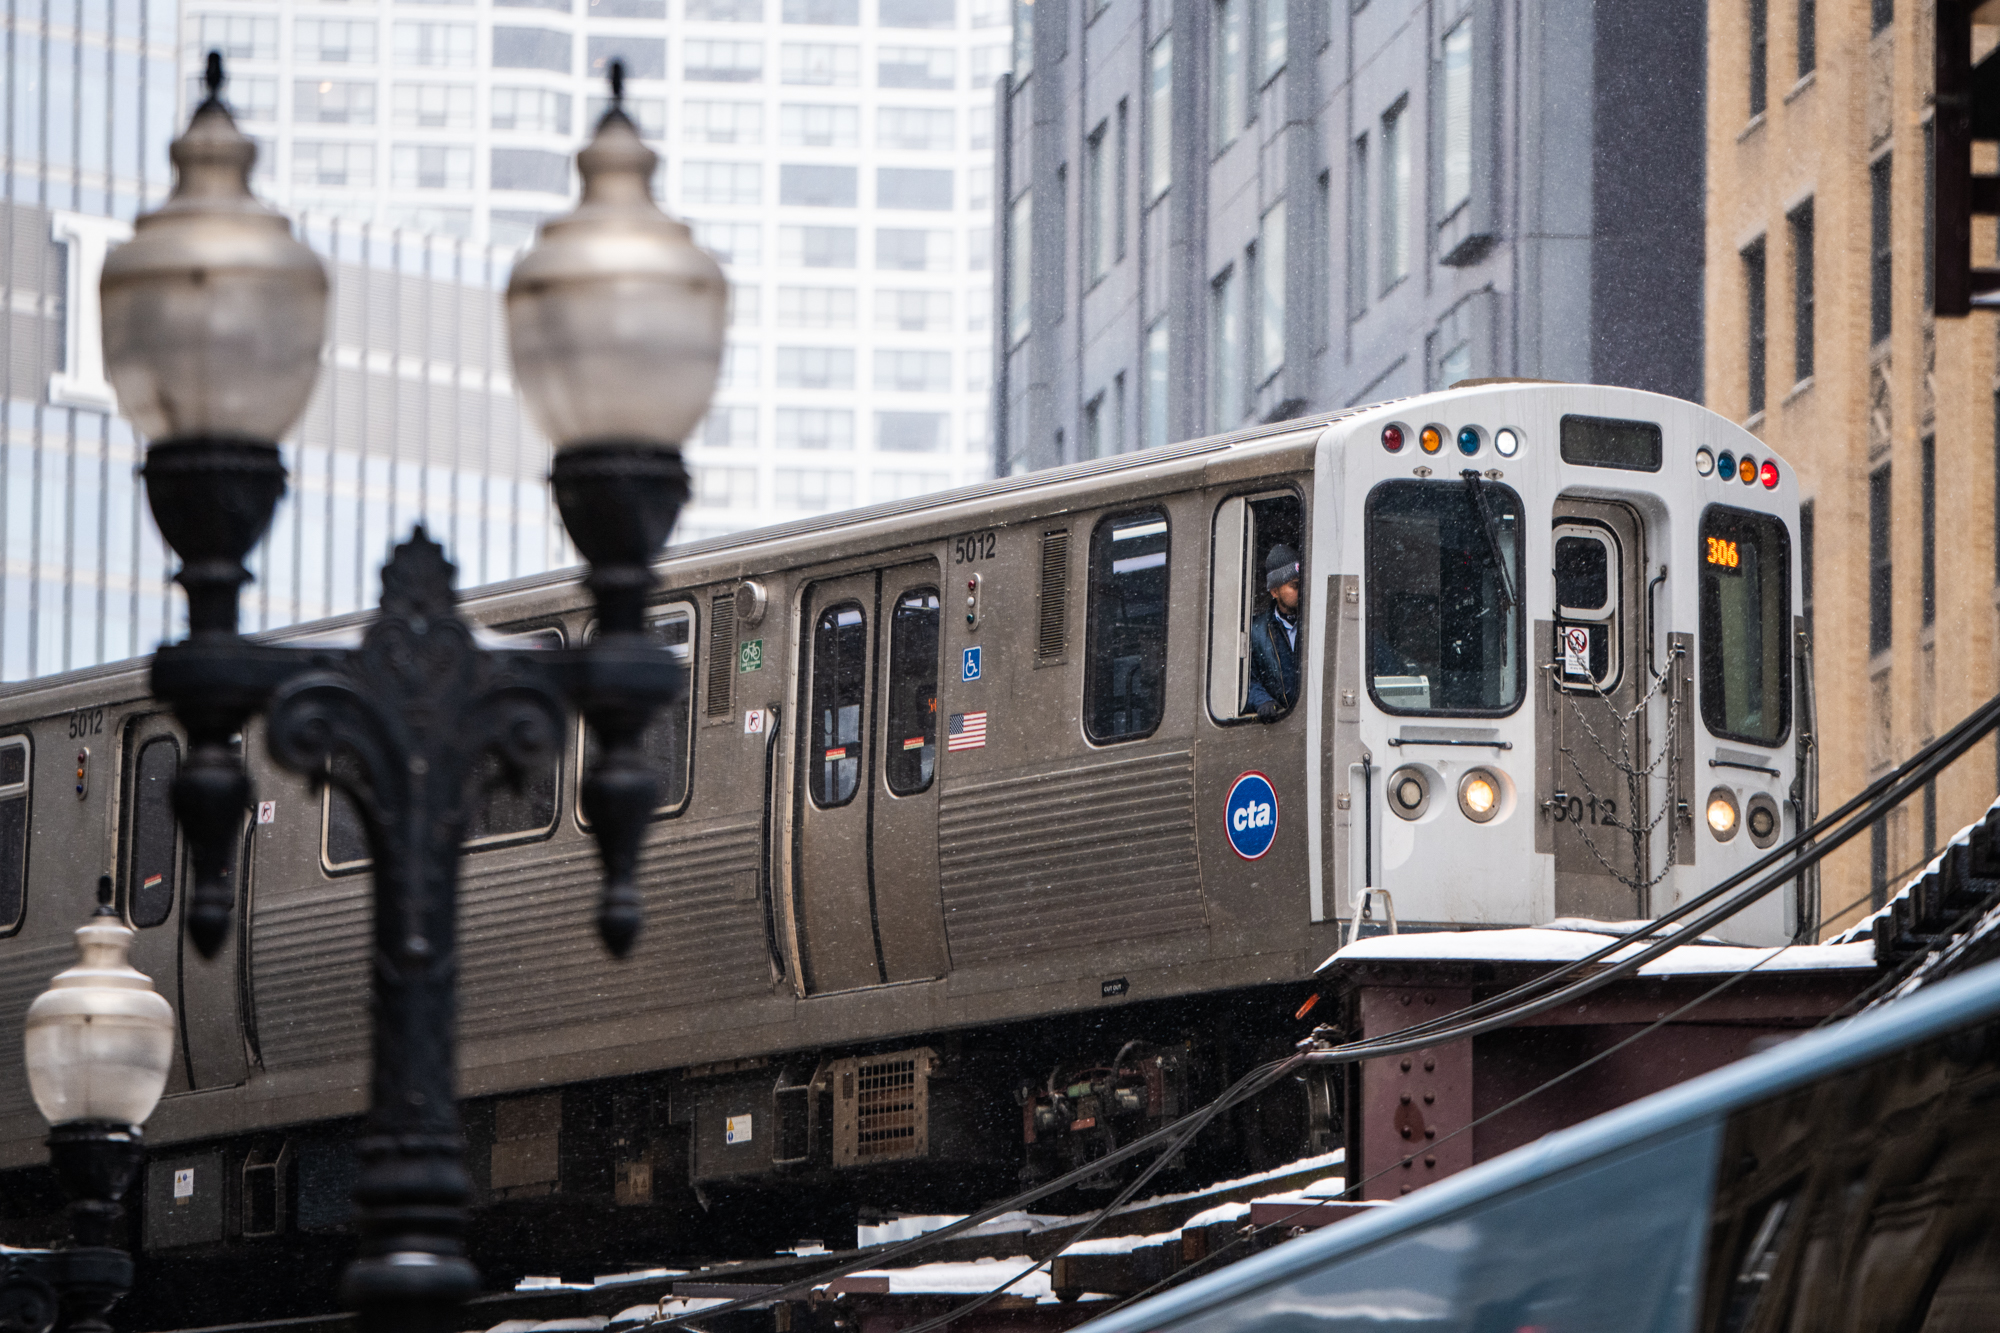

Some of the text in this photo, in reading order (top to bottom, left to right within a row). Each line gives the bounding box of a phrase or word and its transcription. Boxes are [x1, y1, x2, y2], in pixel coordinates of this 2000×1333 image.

[956, 532, 996, 565] 5012
[1707, 536, 1739, 568] 306
[69, 709, 103, 739] 5012
[1233, 800, 1271, 832] cta
[1553, 795, 1618, 826] 5012
